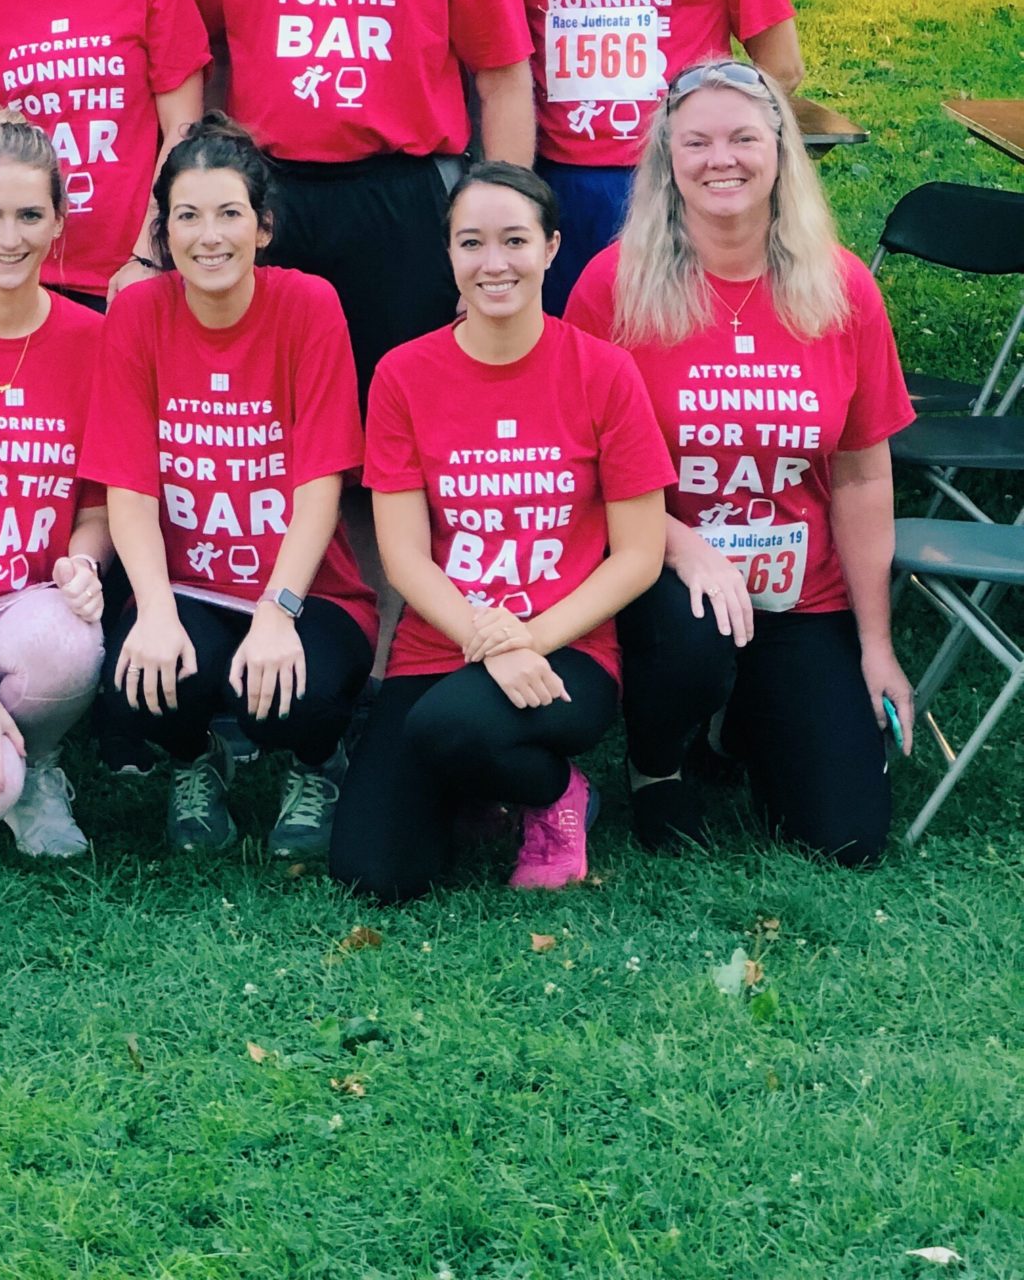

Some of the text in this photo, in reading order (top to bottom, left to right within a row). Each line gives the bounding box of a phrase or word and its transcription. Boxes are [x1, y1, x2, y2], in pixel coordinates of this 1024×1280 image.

[552, 15, 578, 29] Race
[581, 15, 630, 29] Judicata
[9, 35, 111, 60] ATTORNEYS
[277, 15, 391, 60] BAR
[555, 33, 647, 79] 1566
[3, 56, 124, 91] RUNNING
[7, 88, 124, 116] FOR THE
[51, 118, 121, 167] AR
[689, 365, 801, 378] ATTORNEYS
[167, 398, 272, 415] ATTORNEYS
[679, 389, 819, 412] RUNNING
[159, 420, 282, 446] RUNNING
[680, 424, 820, 448] FOR THE
[160, 452, 285, 481] FOR THE
[450, 447, 561, 464] ATTORNEYS
[18, 475, 73, 498] THE
[439, 471, 574, 497] RUNNING
[679, 456, 809, 495] BAR
[163, 483, 288, 537] BAR
[444, 505, 572, 532] FOR THE
[729, 534, 783, 548] Judicata
[789, 530, 802, 544] 19
[445, 531, 563, 585] BAR
[738, 551, 796, 595] 63
